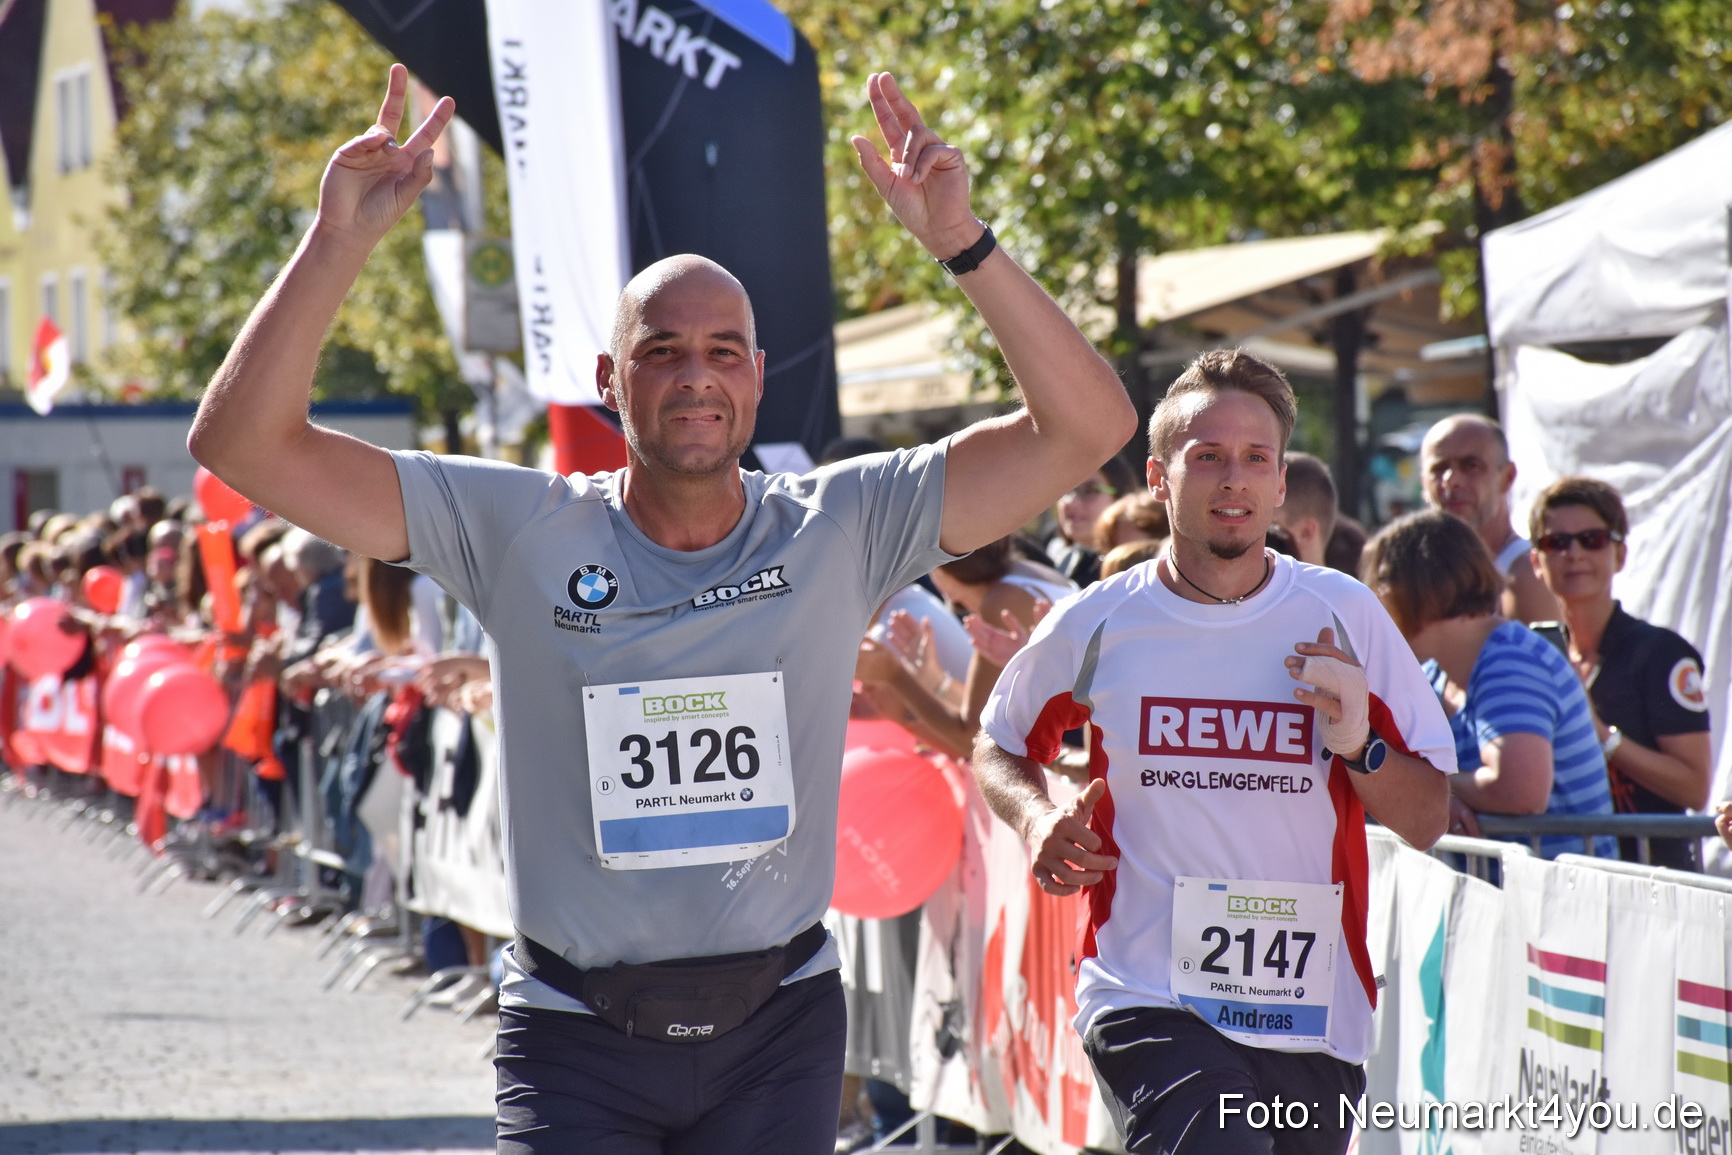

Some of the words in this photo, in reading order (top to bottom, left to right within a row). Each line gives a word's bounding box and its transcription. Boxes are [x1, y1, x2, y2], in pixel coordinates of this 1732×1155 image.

[579, 566, 618, 587] BMW
[692, 565, 788, 609] BOCK
[738, 596, 758, 605] smart
[759, 588, 793, 601] concepts
[554, 605, 602, 627] PARTL
[554, 618, 602, 634] Neumarkt
[642, 691, 728, 716] BOCK
[643, 715, 671, 724] inspired
[701, 711, 730, 720] concepts
[1148, 705, 1306, 756] REWE
[619, 725, 760, 789] 3126
[602, 780, 610, 791] D
[1140, 769, 1313, 794] BURGLENGENFELD
[635, 796, 677, 809] PARTL
[679, 791, 736, 806] Neumarkt
[725, 876, 740, 891] 16.
[1227, 895, 1298, 916] BOCK
[1226, 912, 1251, 921] inspired
[1251, 913, 1260, 922] by
[1200, 925, 1317, 979] 2147
[1210, 982, 1246, 995] PARTL
[1248, 986, 1292, 997] Neumarkt
[1217, 1005, 1293, 1031] Andreas
